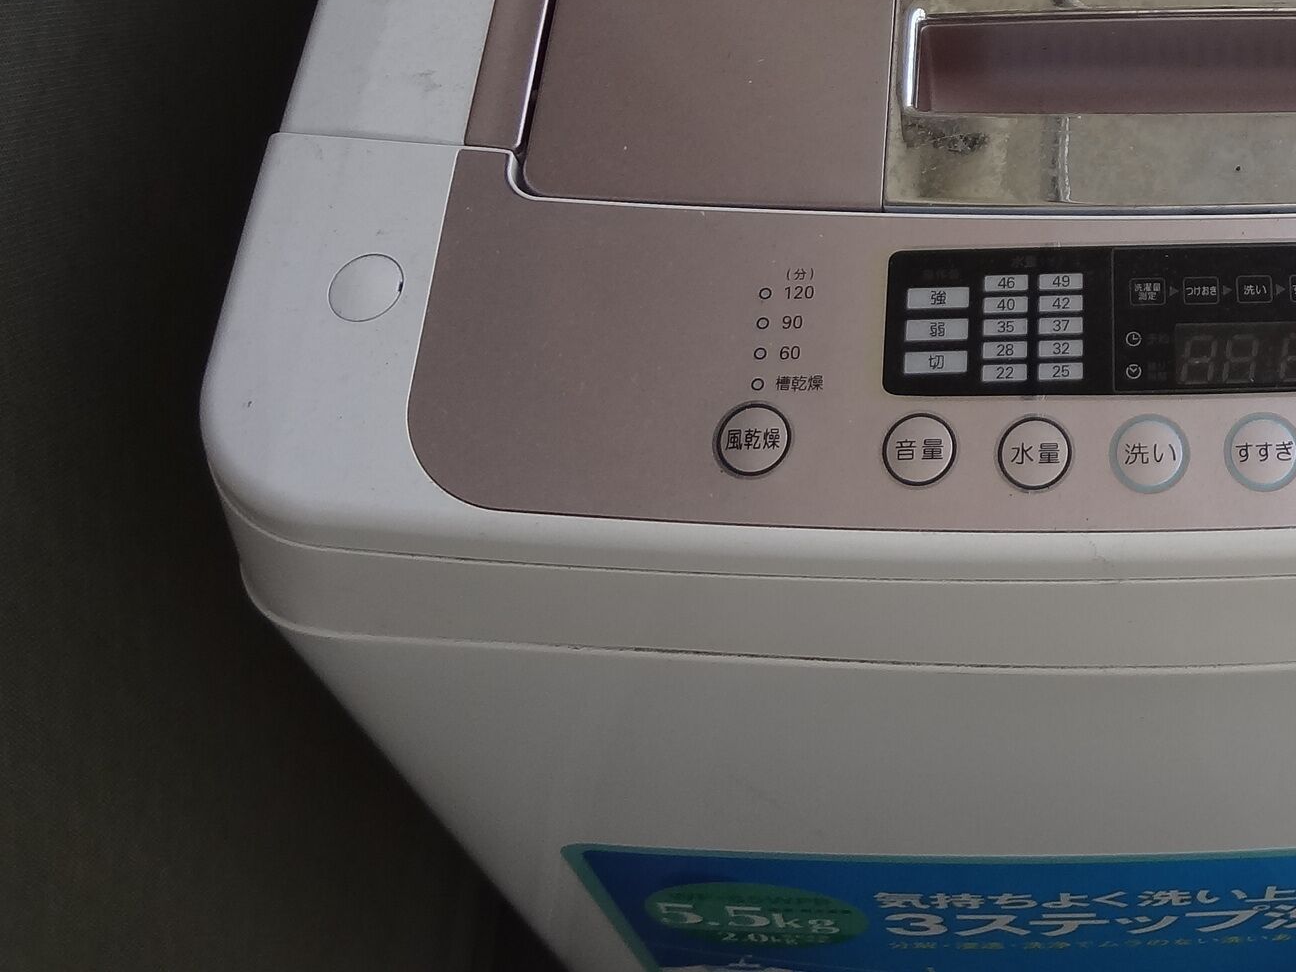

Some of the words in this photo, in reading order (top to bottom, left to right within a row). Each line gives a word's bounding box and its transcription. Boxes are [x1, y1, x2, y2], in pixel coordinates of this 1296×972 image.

[786, 267, 815, 281] (分)
[997, 276, 1015, 290] 46
[1052, 274, 1070, 288] 49
[784, 285, 814, 300] 120
[929, 290, 947, 306] 強
[1185, 285, 1217, 296] つけおき
[1243, 284, 1268, 296] 洗い
[997, 297, 1015, 311] 40
[1052, 296, 1070, 310] 42
[781, 315, 804, 330] 90
[928, 321, 946, 338] 弱
[997, 320, 1015, 334] 35
[1052, 319, 1070, 332] 37
[779, 345, 801, 360] 60
[996, 343, 1014, 357] 28
[1052, 342, 1070, 356] 32
[928, 354, 945, 370] 切
[995, 366, 1014, 380] 22
[1052, 365, 1070, 378] 25
[775, 374, 824, 392] 槽乾燥
[725, 428, 781, 451] 風乾燥
[894, 438, 945, 462] 音量
[1010, 441, 1062, 466] 水量
[1124, 441, 1178, 466] 洗い
[1235, 440, 1295, 464] すすぎ
[655, 902, 842, 935] 5.5kg
